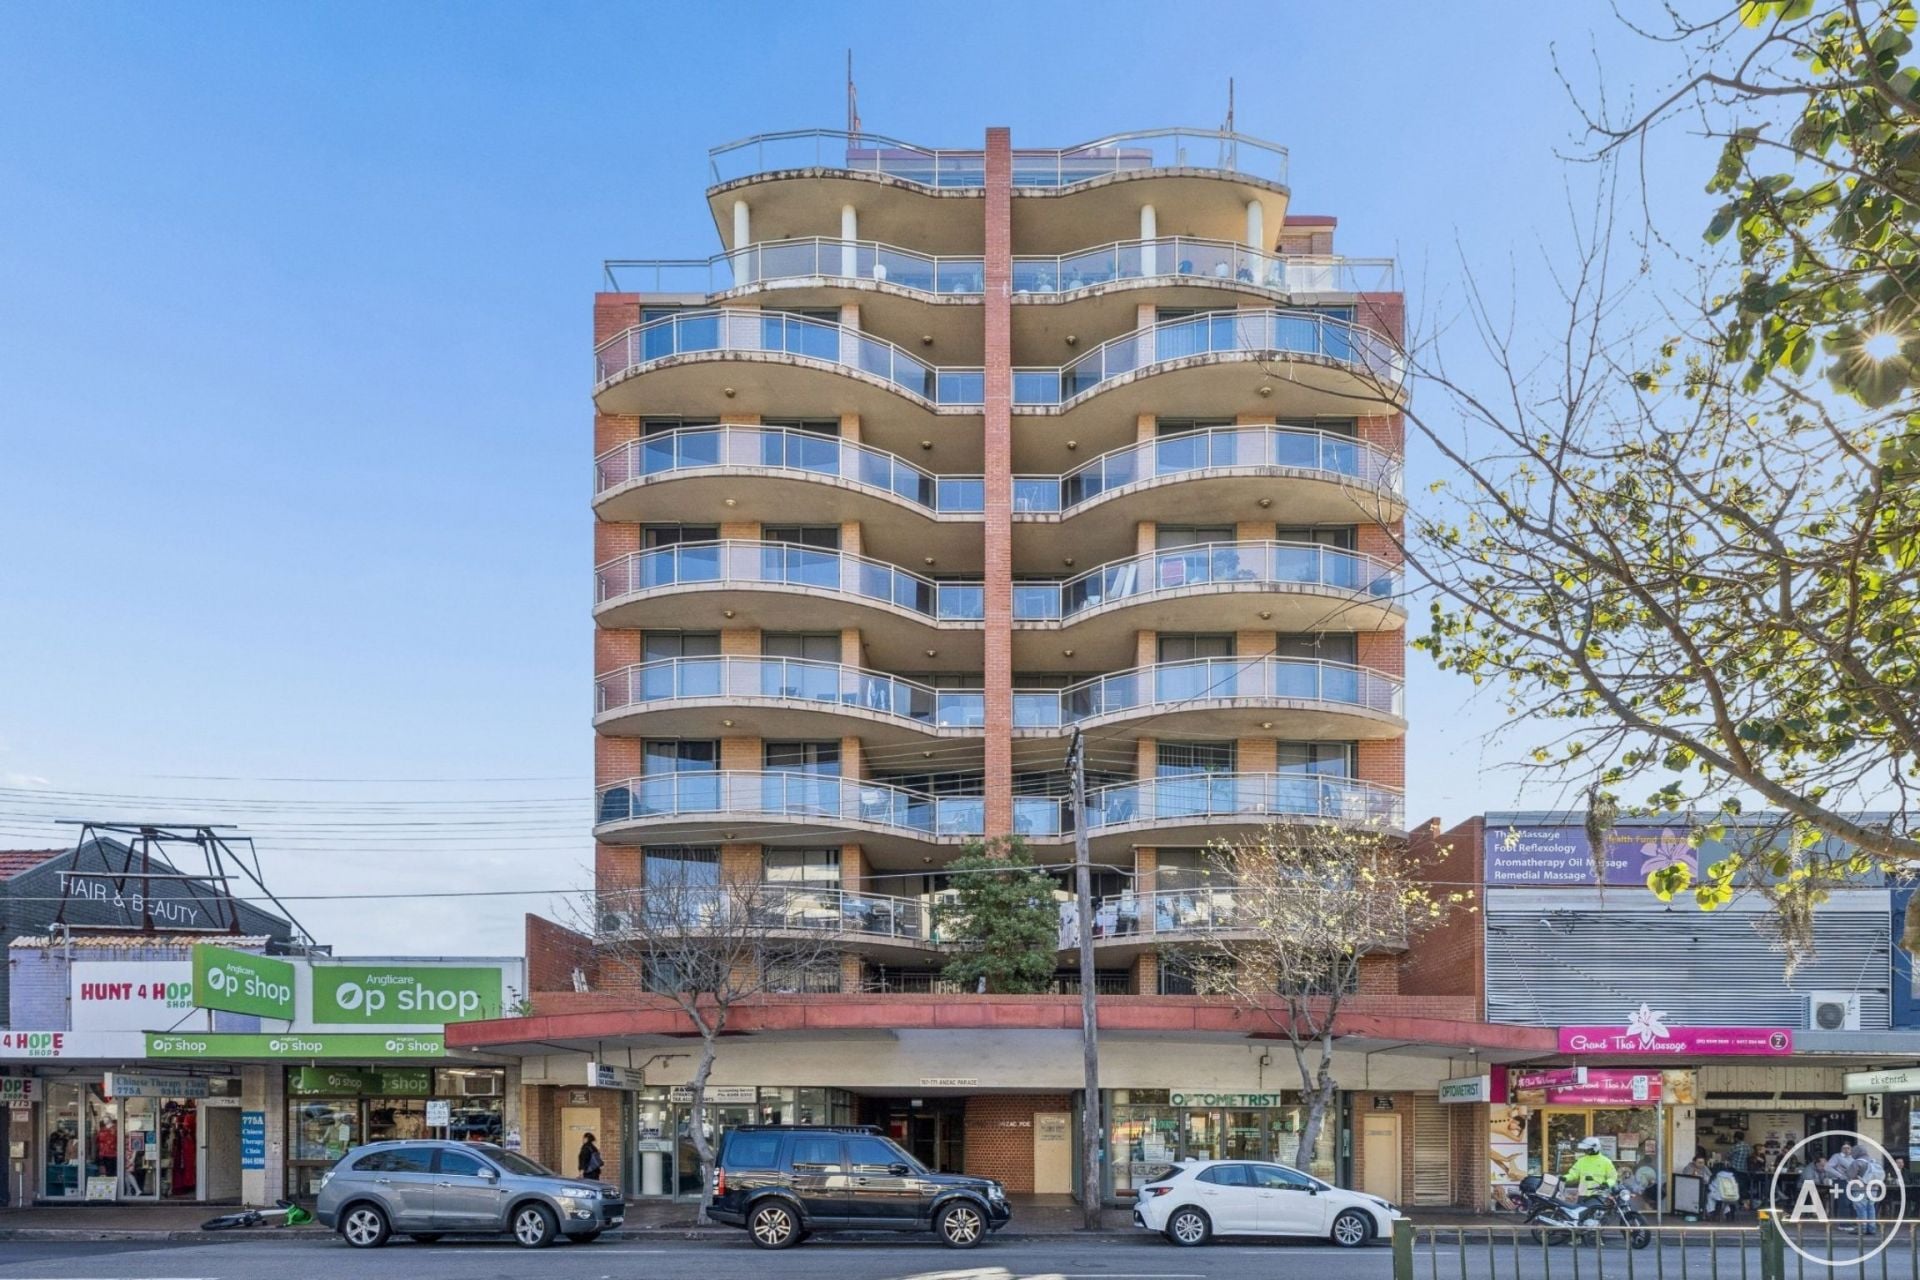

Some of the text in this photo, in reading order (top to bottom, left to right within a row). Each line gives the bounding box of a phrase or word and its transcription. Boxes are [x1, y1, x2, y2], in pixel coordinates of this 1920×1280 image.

[1519, 844, 1576, 854] Reflexology
[1494, 858, 1565, 869] Aromatherapy
[1569, 858, 1582, 868] Oil
[1494, 871, 1586, 881] Remedial Massage
[60, 873, 198, 925] HAIR & BEAUTY
[365, 974, 414, 987] Anglicare
[81, 983, 133, 1001] HUNT
[137, 984, 147, 999] 4
[244, 975, 291, 1006] shop
[166, 1000, 192, 1008] SHOP
[336, 982, 480, 1018] Op shop
[3, 1033, 64, 1049] 4 HOPE
[176, 1039, 207, 1053] shop
[292, 1039, 323, 1053] shop
[408, 1039, 439, 1053] shop
[1570, 1035, 1686, 1053] Grand Thai Massage
[28, 1049, 52, 1057] SHOP
[0, 1079, 32, 1093] OPE
[116, 1076, 148, 1086] Chinese
[149, 1078, 181, 1089] Therapy
[343, 1076, 362, 1089] shop
[391, 1077, 429, 1092] shop
[117, 1087, 142, 1095] 775A
[1442, 1083, 1479, 1098] OPTOMETRIST
[1171, 1093, 1280, 1106] OPTOMETRIST
[242, 1116, 264, 1125] 775A
